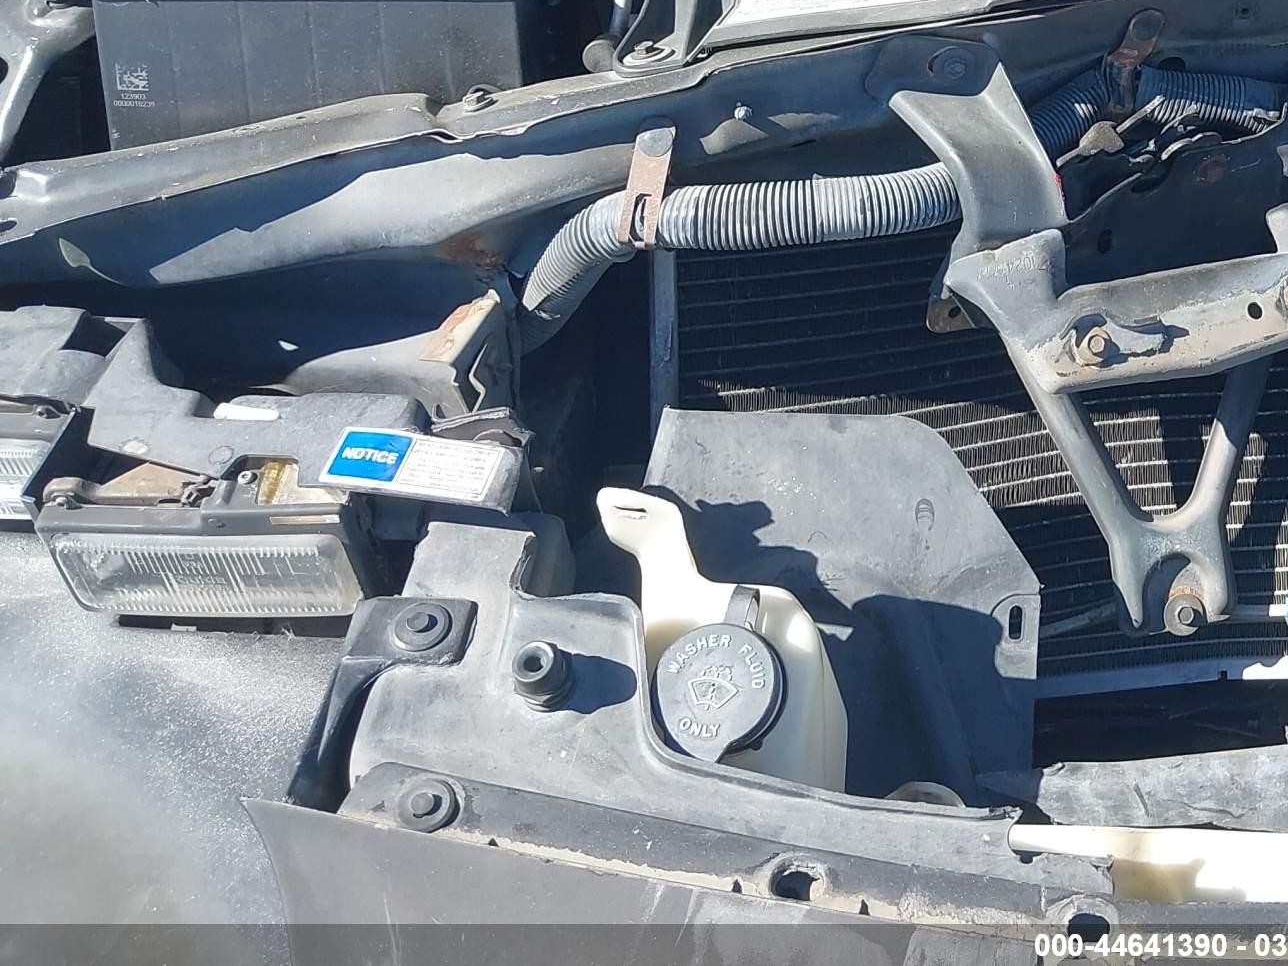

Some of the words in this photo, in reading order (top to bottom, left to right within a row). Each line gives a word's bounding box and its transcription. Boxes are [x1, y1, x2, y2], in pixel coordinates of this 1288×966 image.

[341, 446, 399, 465] NOTICE
[666, 634, 732, 674] WASHER
[738, 643, 766, 689] FLUID
[679, 717, 720, 738] ONLY
